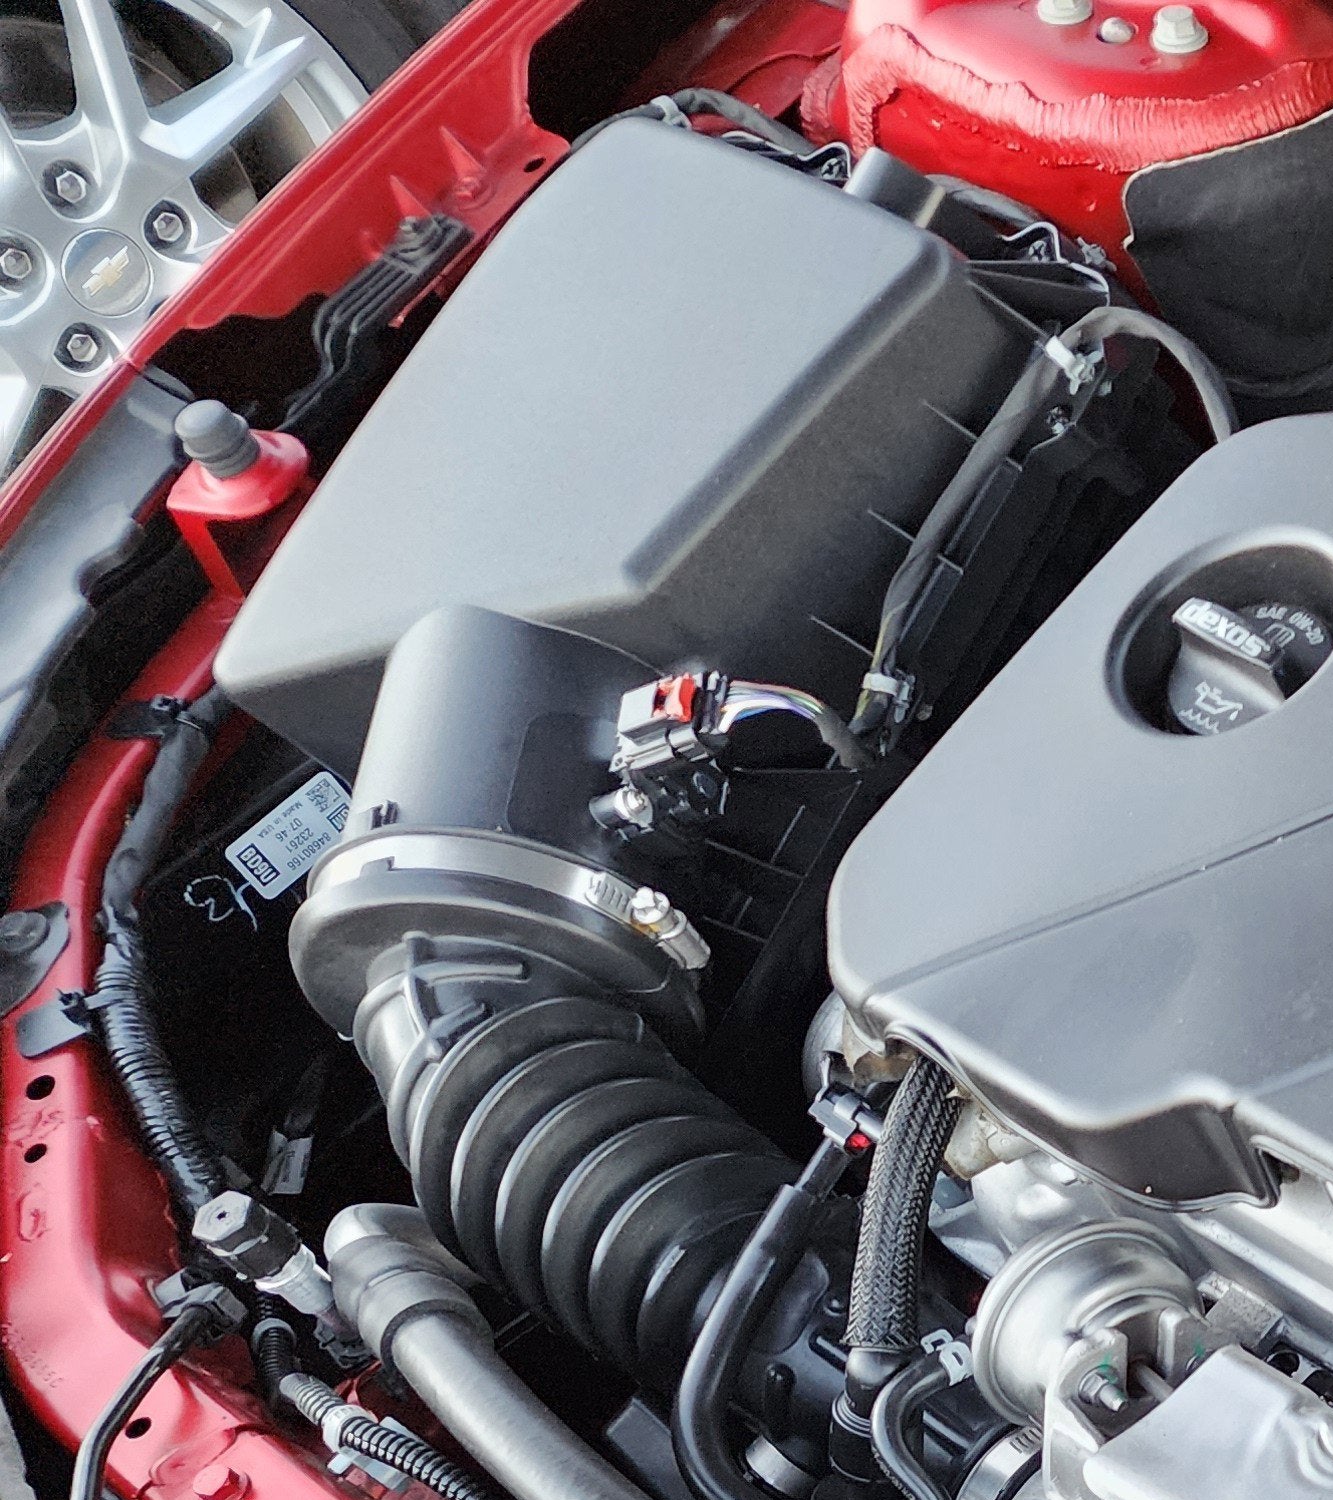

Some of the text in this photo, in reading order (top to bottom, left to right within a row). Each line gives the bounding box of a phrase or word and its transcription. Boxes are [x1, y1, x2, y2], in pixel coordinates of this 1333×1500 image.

[1256, 604, 1288, 620] SAE
[282, 800, 304, 819] Made
[257, 824, 275, 839] USA
[275, 817, 303, 842] 07:46
[285, 828, 314, 853] 23261
[287, 832, 332, 871] 84680166
